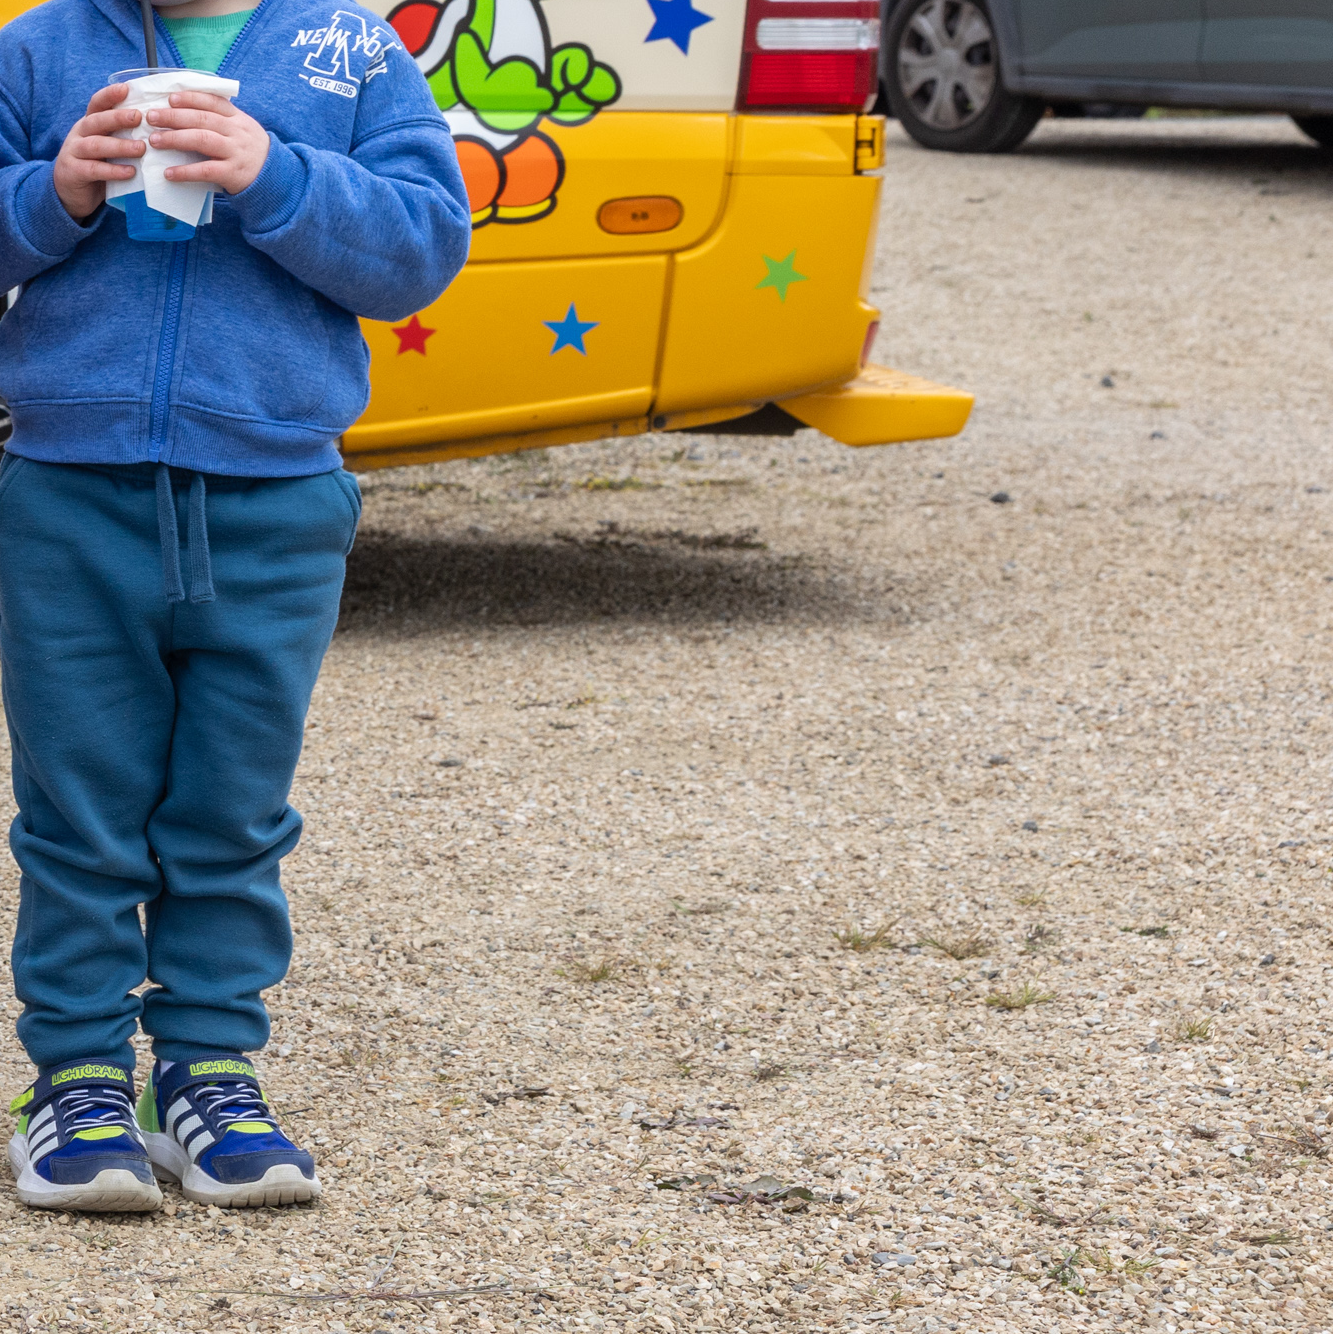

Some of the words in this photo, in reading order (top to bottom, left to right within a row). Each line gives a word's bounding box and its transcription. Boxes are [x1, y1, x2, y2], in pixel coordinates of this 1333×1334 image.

[290, 27, 353, 48] NEW
[312, 78, 331, 90] EST.
[333, 82, 355, 97] 1996
[51, 1063, 128, 1086] LIGHTORAMA
